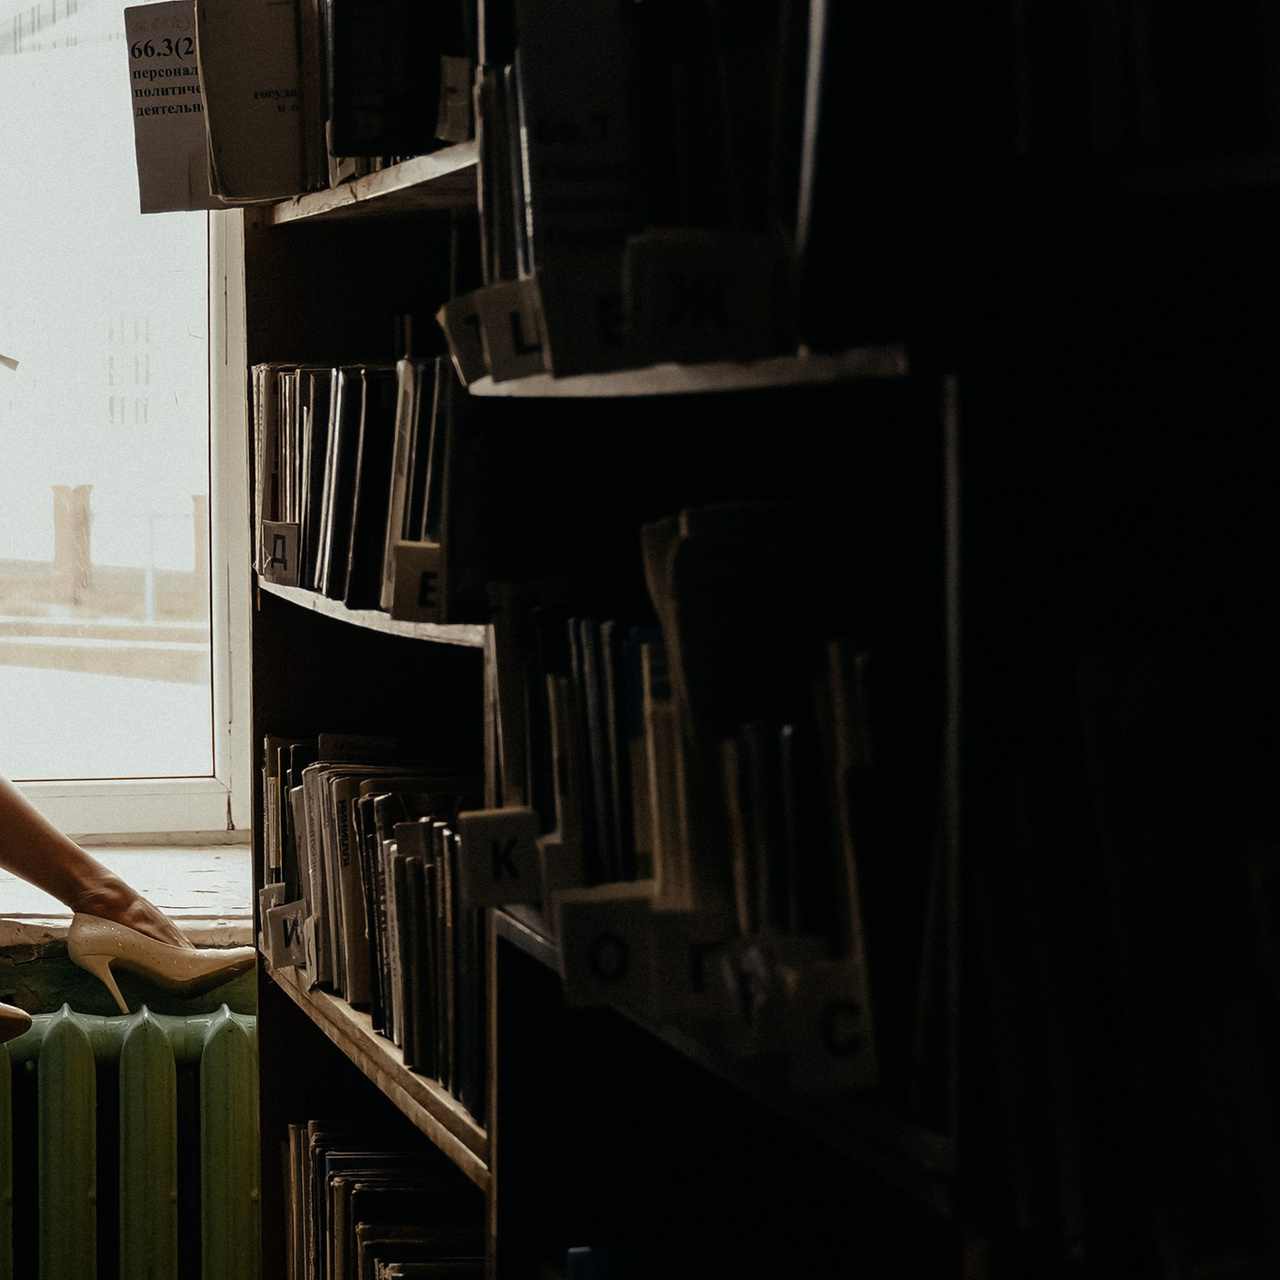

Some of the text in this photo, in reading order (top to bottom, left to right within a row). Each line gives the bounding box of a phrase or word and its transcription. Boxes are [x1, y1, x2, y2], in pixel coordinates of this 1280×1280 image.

[131, 37, 194, 60] 66.3(2
[136, 103, 204, 117] деятельн
[664, 271, 731, 332] Ж
[271, 534, 287, 571] Д
[418, 571, 438, 607] Е
[490, 838, 519, 881] К
[588, 932, 630, 982] О
[820, 999, 862, 1059] С
